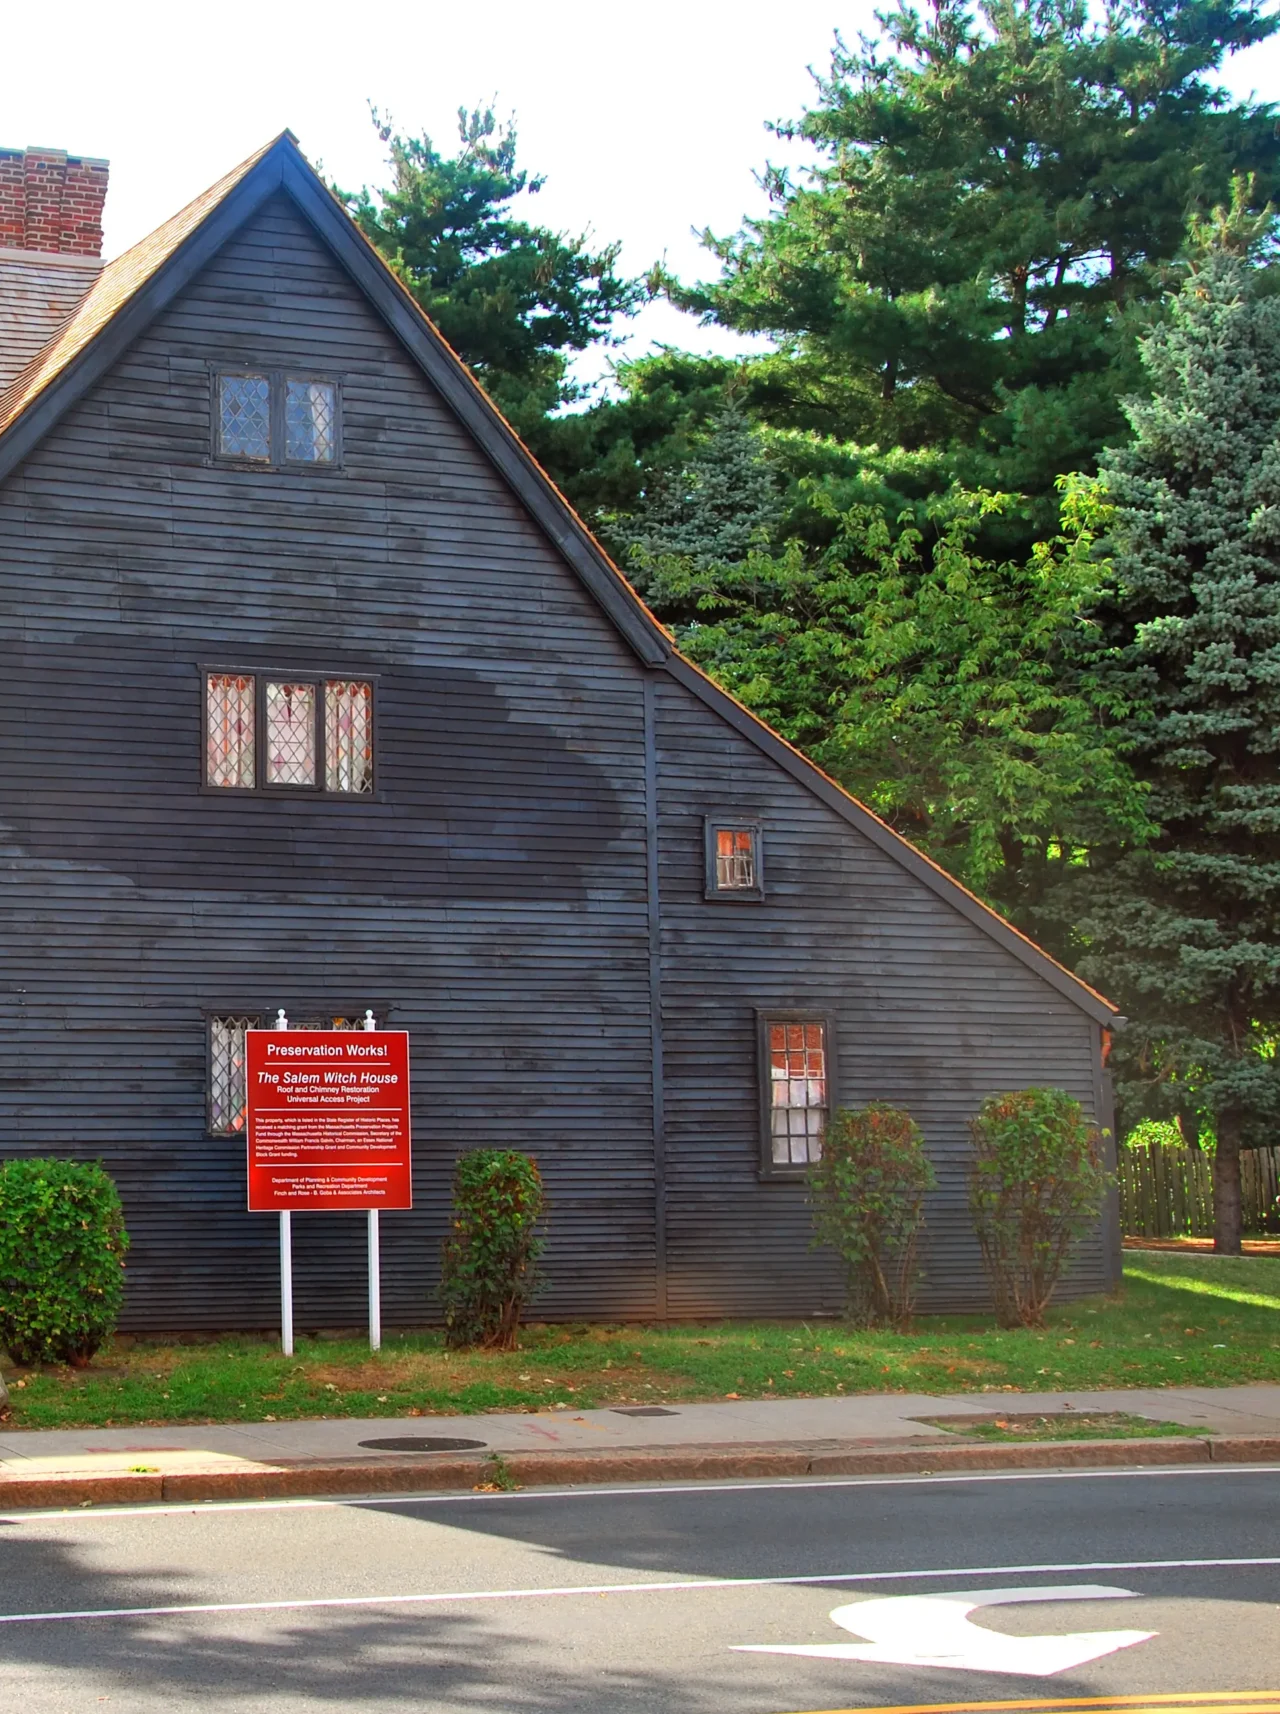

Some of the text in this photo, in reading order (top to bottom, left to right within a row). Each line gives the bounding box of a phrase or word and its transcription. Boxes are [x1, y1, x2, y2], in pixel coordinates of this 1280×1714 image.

[267, 1044, 388, 1056] Preservation Works!
[257, 1071, 398, 1084] The Salem Witch House
[277, 1085, 379, 1094] Roof and Chimney Restoration
[287, 1095, 370, 1104] Universal Access Project
